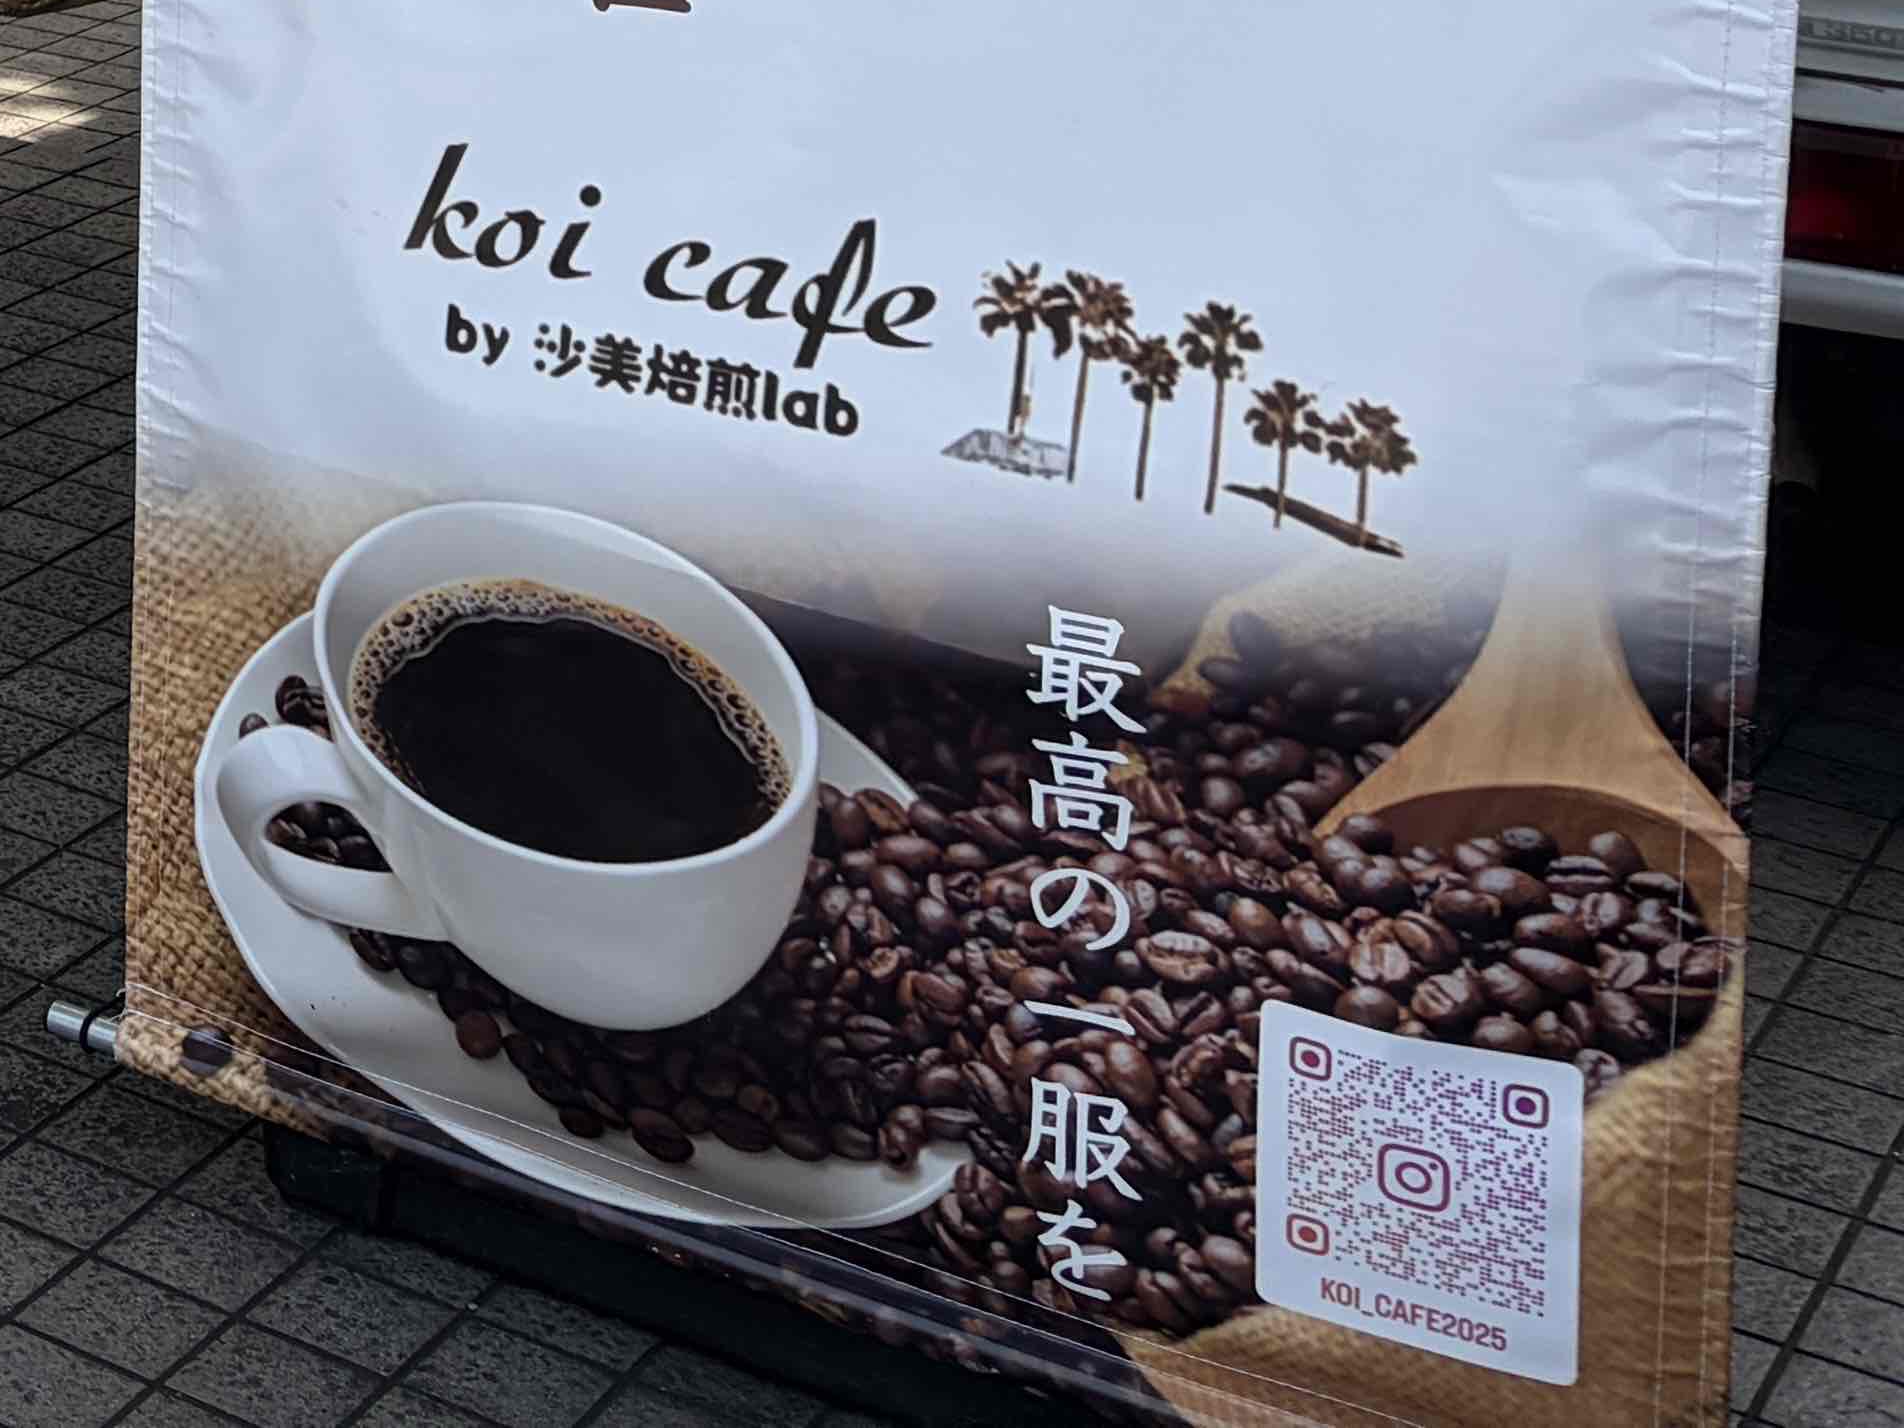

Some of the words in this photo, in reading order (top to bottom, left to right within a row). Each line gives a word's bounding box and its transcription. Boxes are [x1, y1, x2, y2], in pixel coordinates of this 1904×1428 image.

[402, 140, 602, 283] koi
[642, 216, 937, 369] cafe
[444, 303, 511, 368] by
[533, 320, 859, 438] 沙美焙煎lab
[1022, 602, 1146, 1302] 最高の一服を
[1318, 1274, 1507, 1354] KOI_CAFE2025
